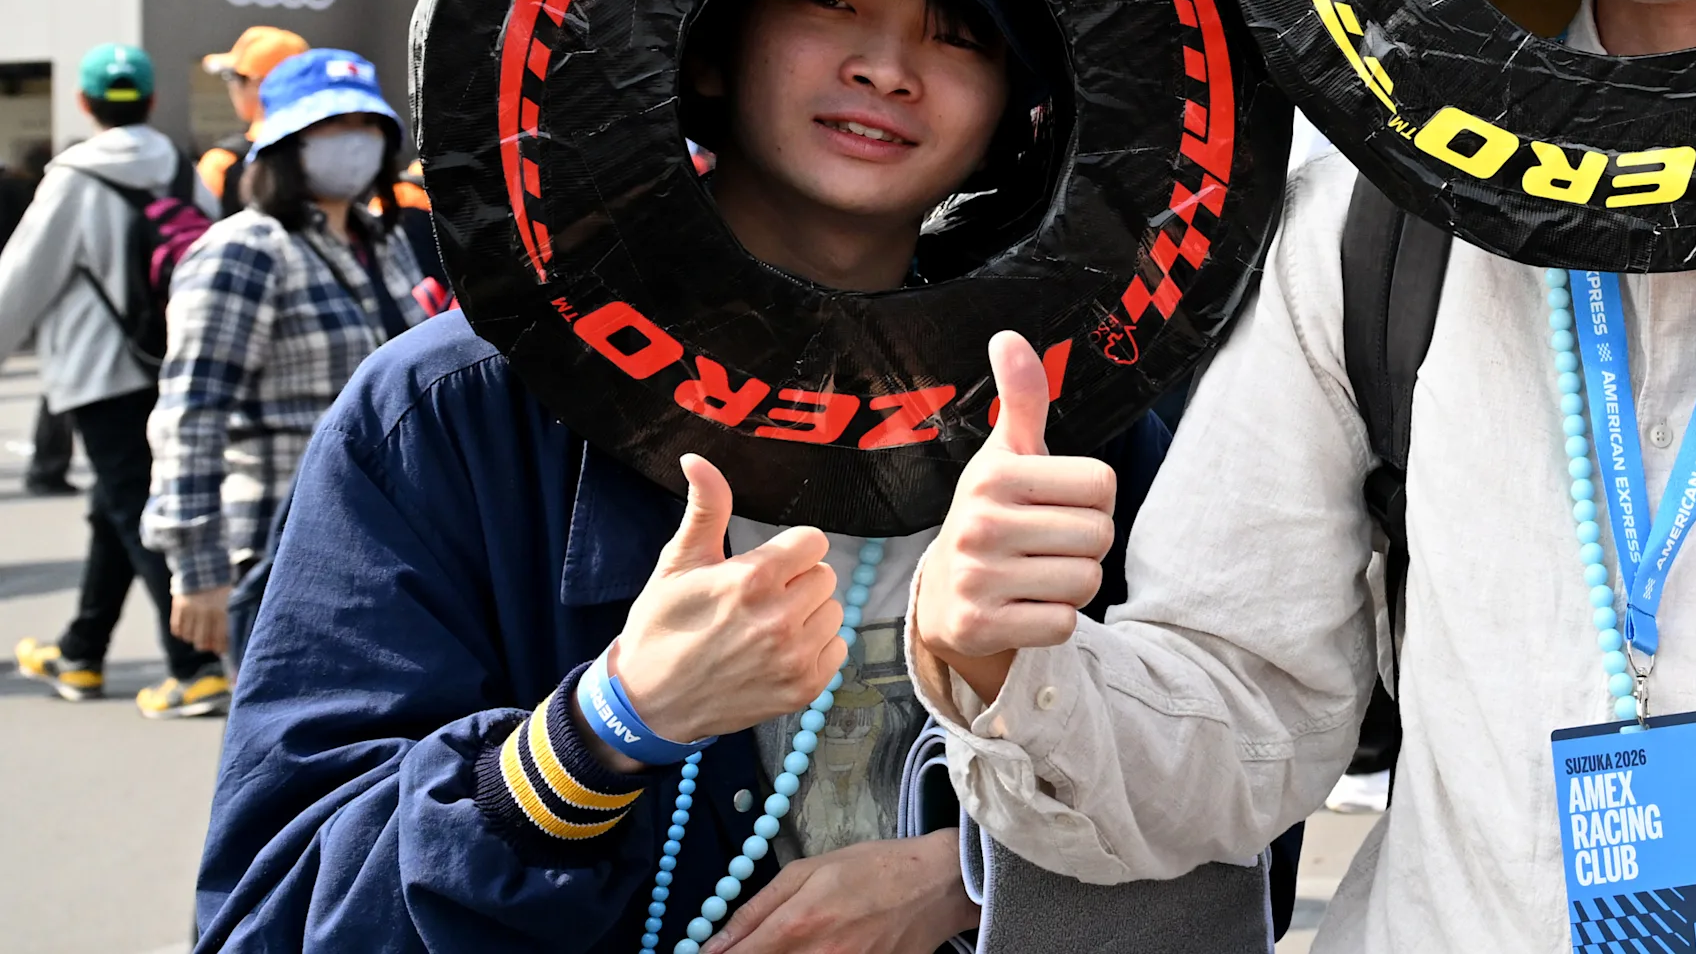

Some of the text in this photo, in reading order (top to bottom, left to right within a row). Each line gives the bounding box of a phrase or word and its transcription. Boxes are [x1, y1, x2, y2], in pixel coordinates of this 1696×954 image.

[1586, 270, 1608, 337] PRESS
[1601, 370, 1641, 564] AMERICAN EXPRESS
[589, 692, 641, 744] AMER
[1565, 749, 1647, 775] SUZUKA 2026
[1569, 770, 1636, 813] AMEX
[1571, 804, 1663, 850] RACING
[1575, 845, 1639, 886] CLUB
